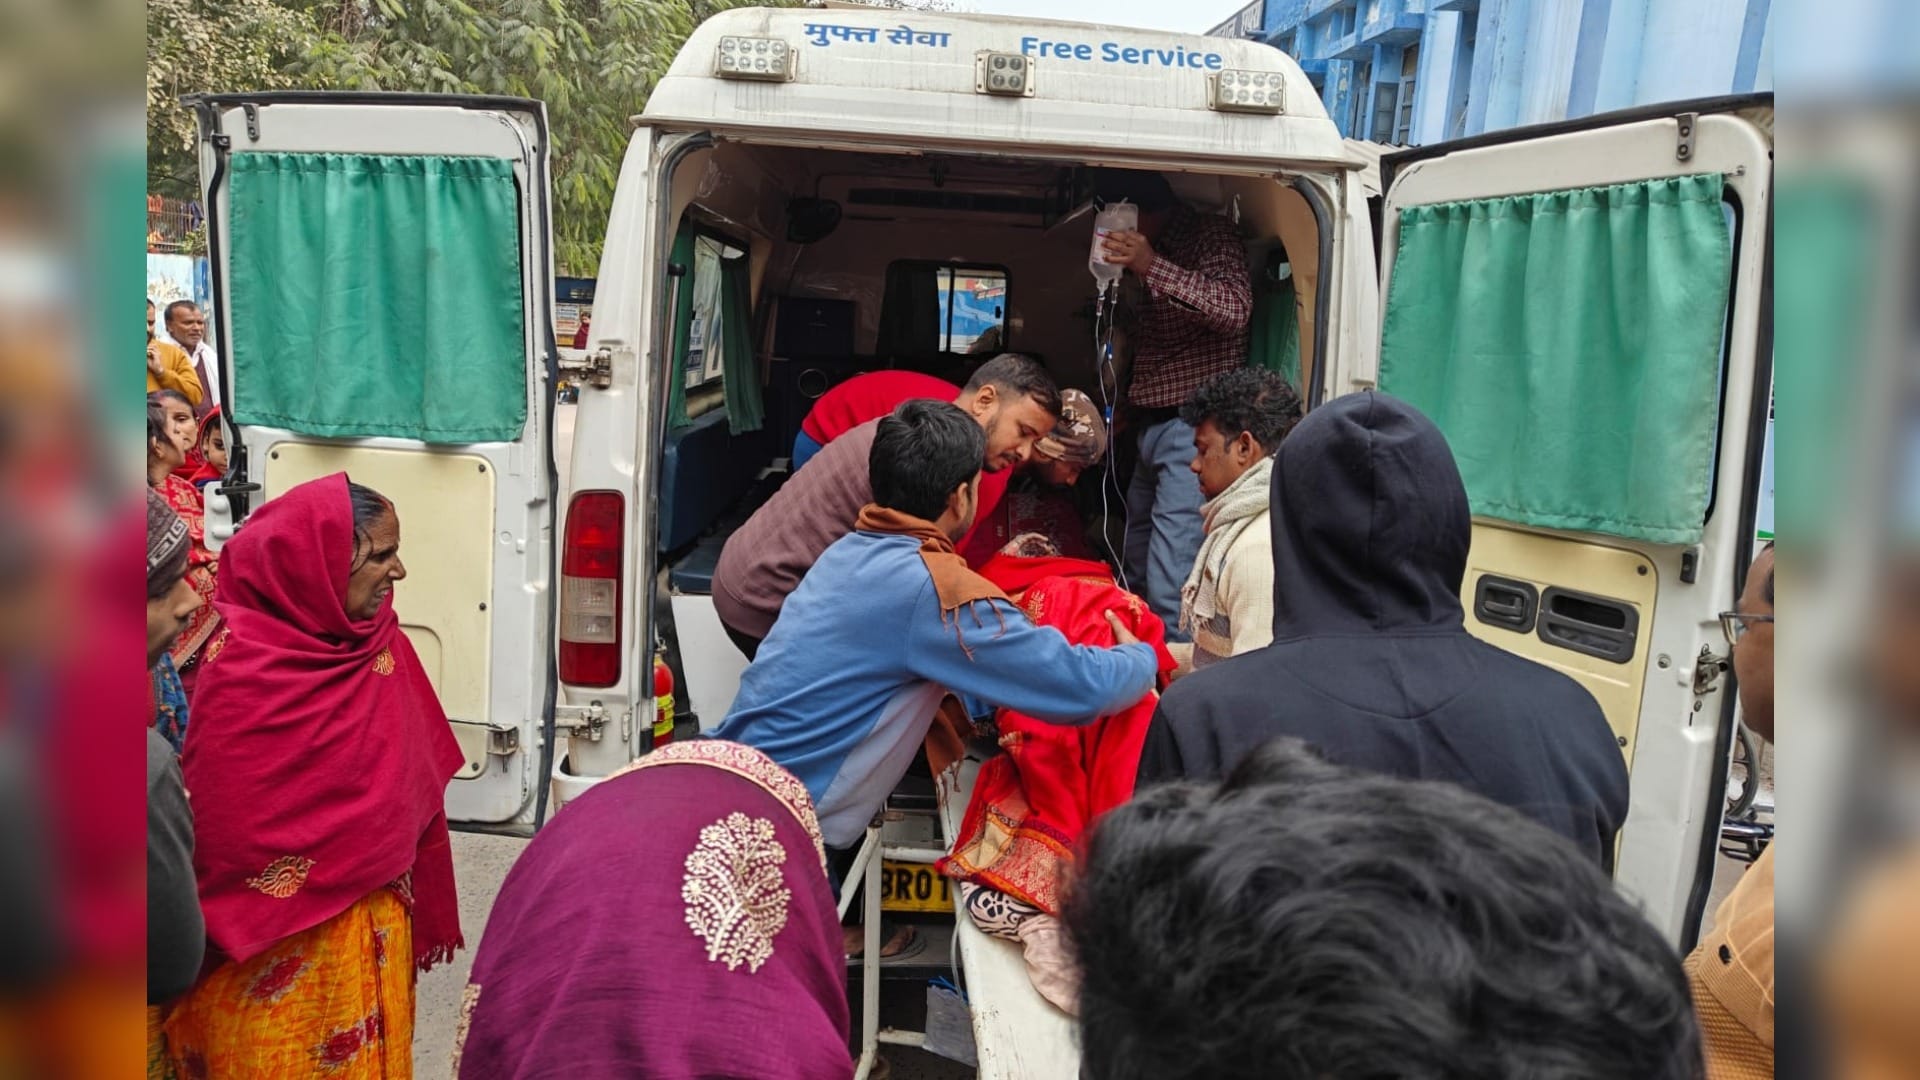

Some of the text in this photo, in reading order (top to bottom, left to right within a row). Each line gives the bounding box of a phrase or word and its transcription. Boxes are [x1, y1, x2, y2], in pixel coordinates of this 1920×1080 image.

[804, 23, 952, 47] मुफ्त सेवा
[1021, 37, 1223, 69] Free Service
